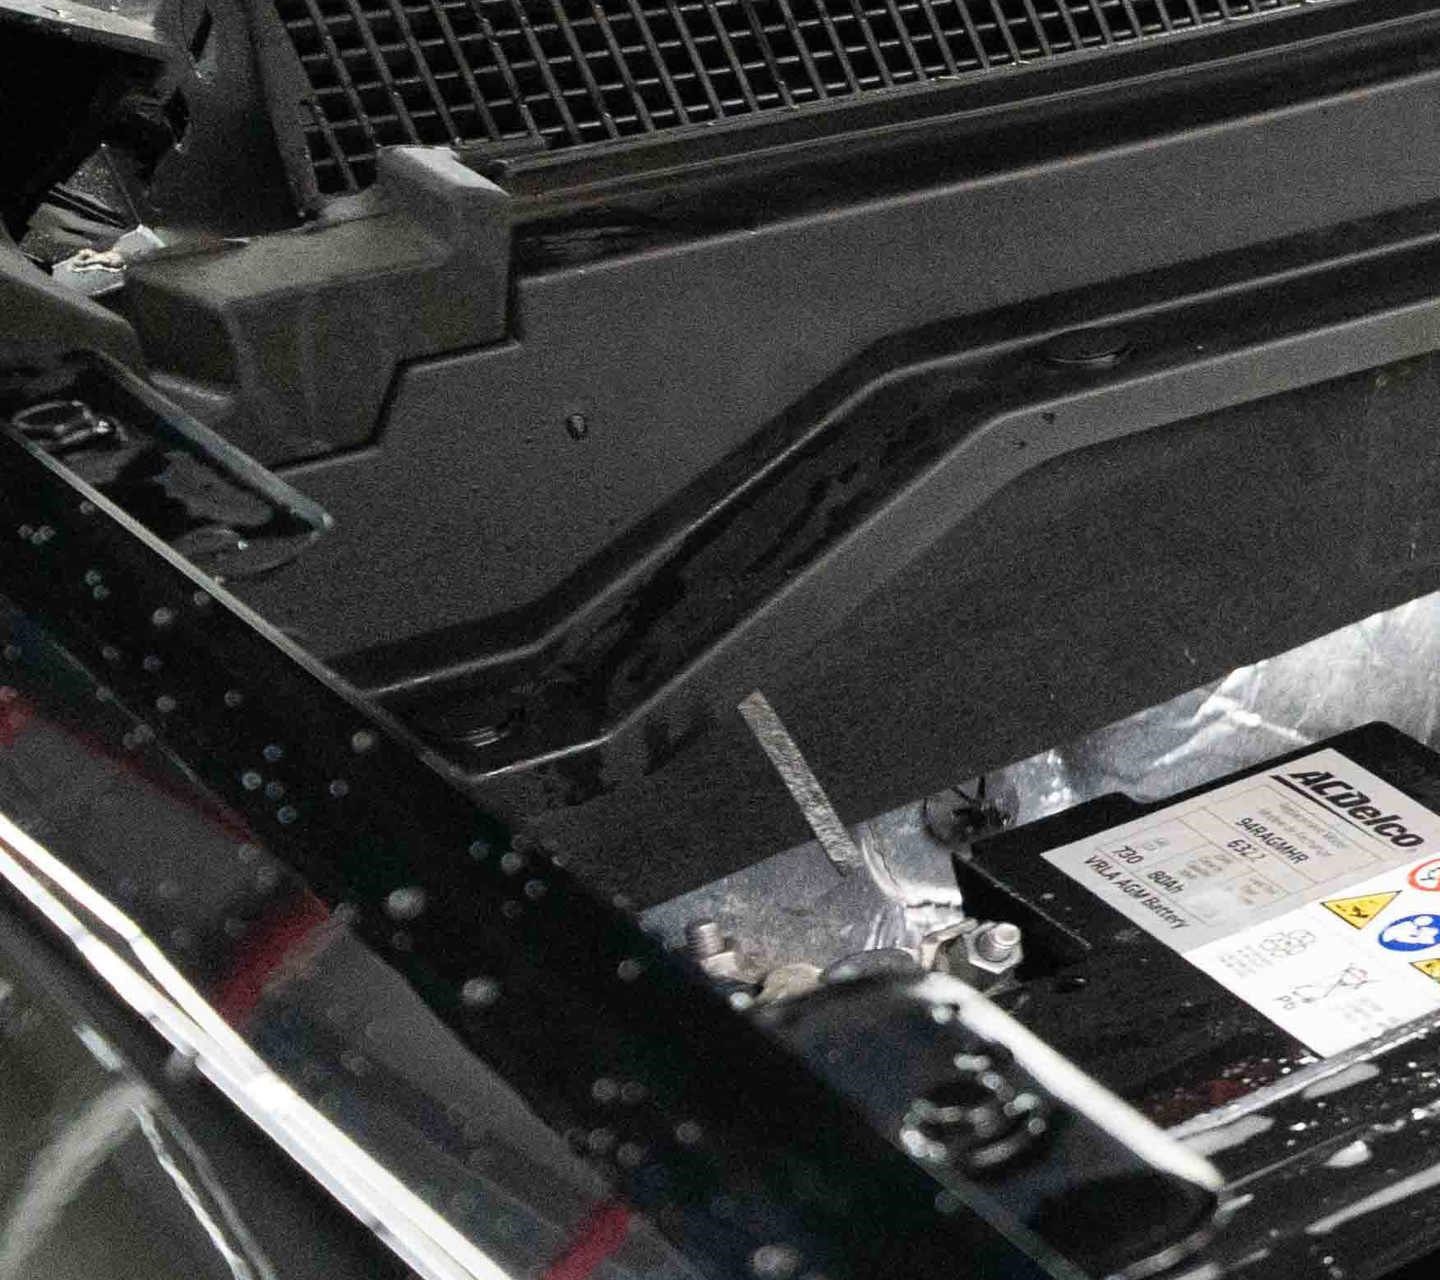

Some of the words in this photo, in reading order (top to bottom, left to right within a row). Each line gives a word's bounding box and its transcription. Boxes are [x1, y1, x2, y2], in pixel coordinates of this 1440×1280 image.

[1288, 771, 1425, 848] ACDelco
[1112, 845, 1144, 864] 730
[1084, 855, 1121, 881] VRLA
[1112, 880, 1150, 901] AGM
[1142, 896, 1190, 929] Battery
